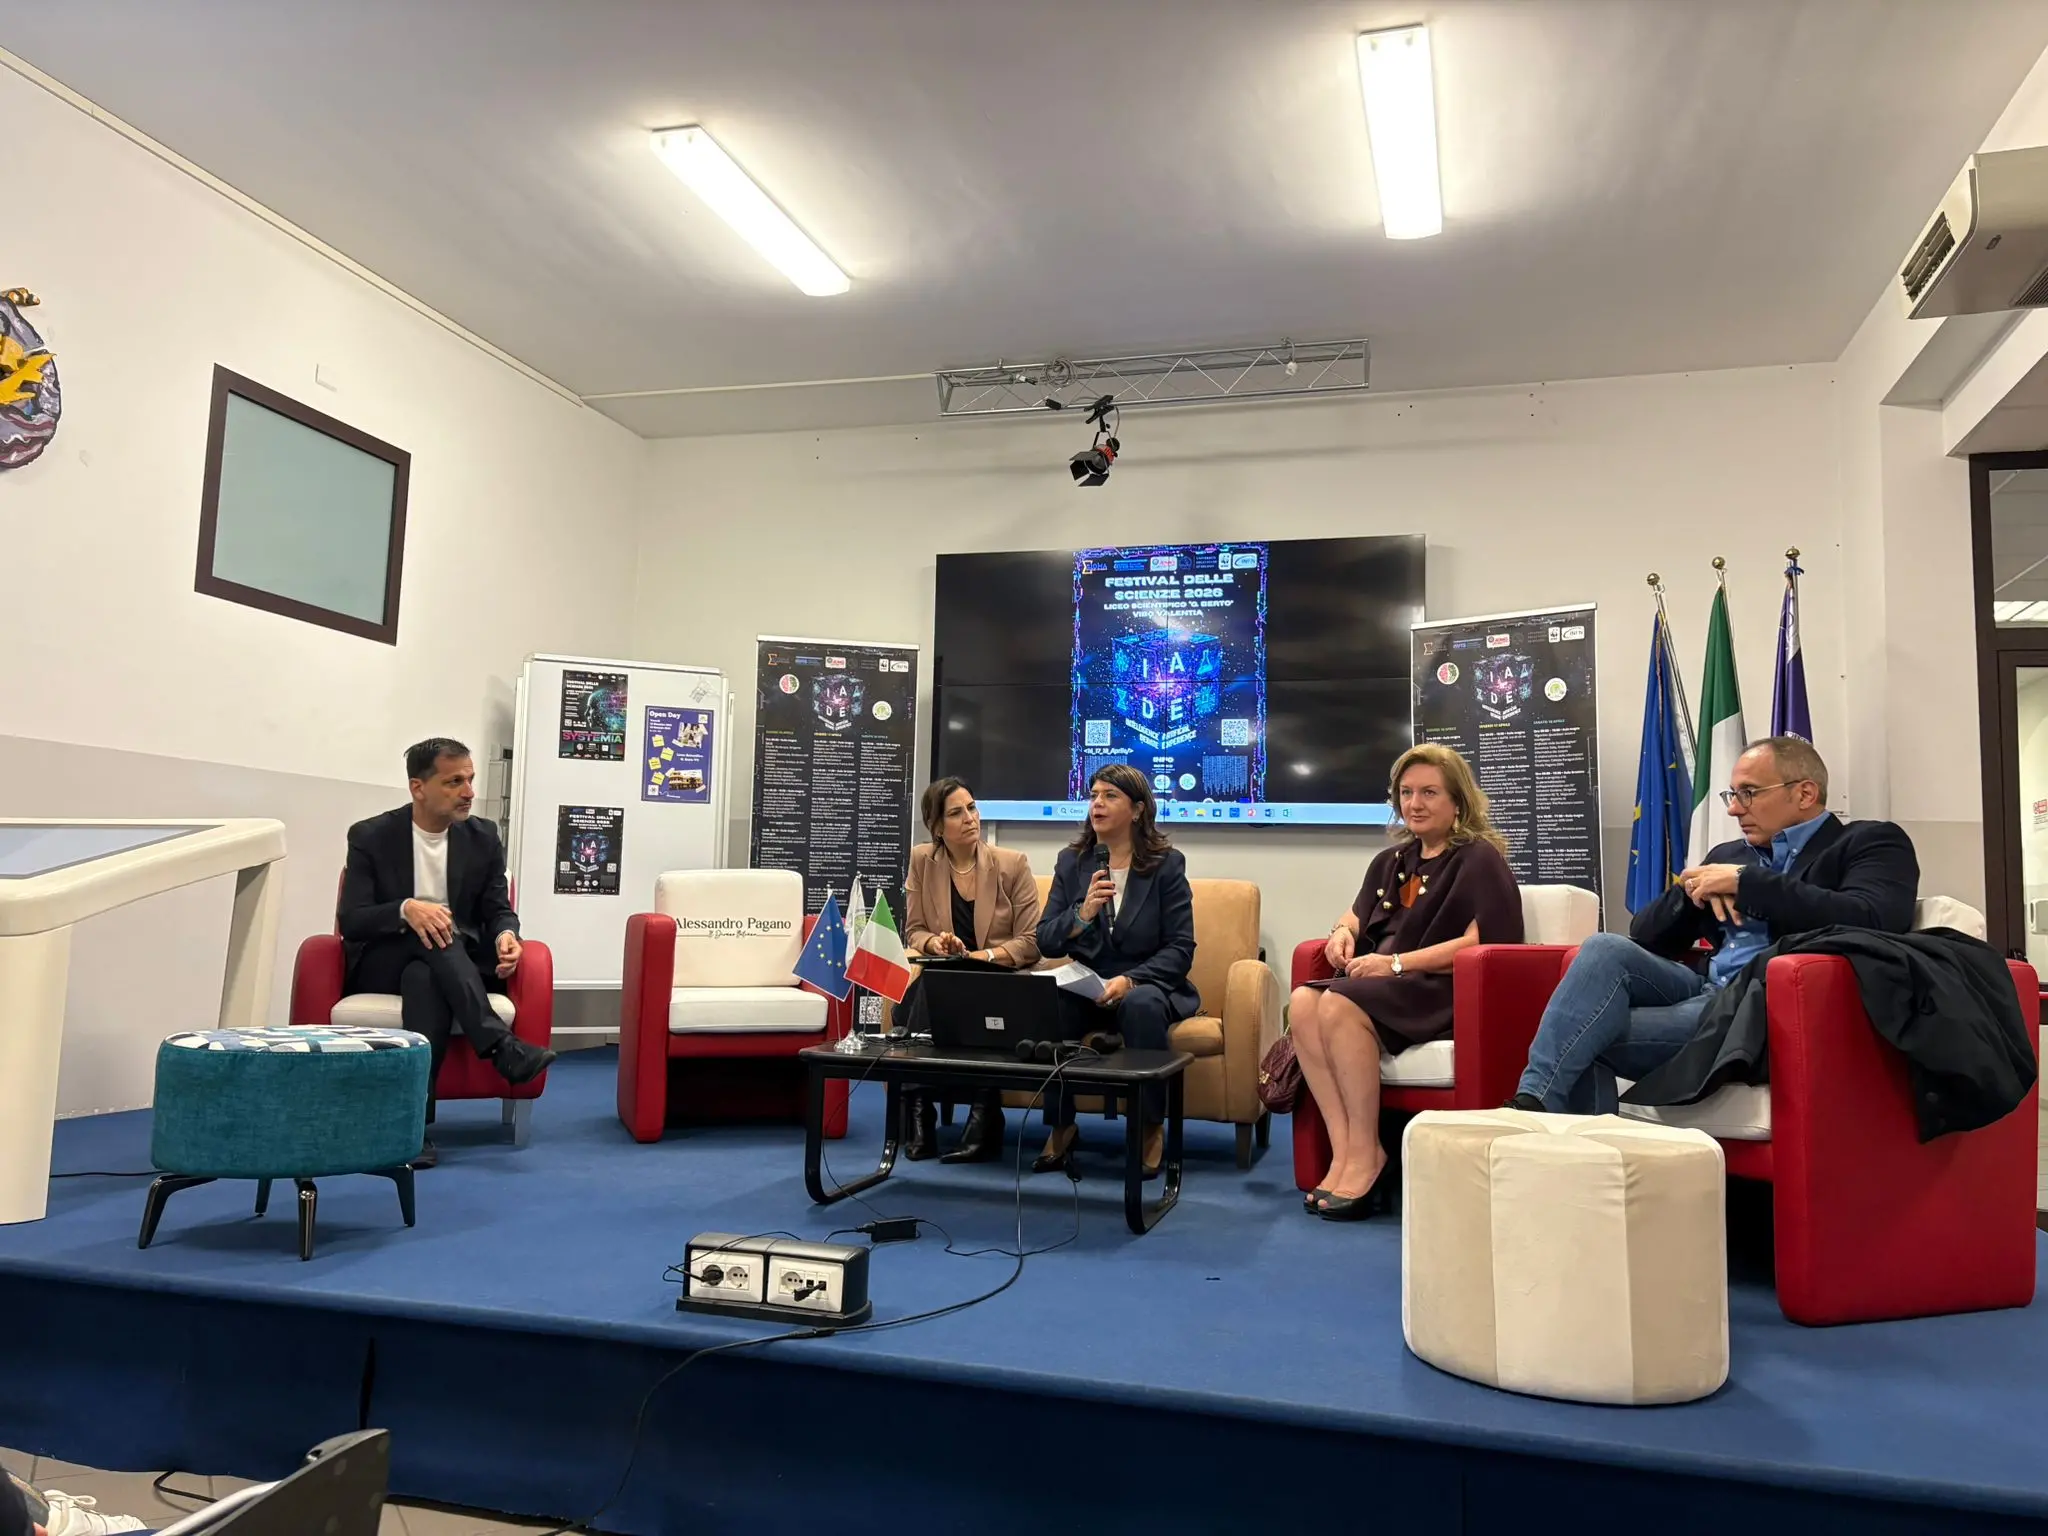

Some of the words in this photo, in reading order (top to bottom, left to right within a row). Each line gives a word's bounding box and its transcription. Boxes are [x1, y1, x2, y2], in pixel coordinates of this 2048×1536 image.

[1105, 575, 1180, 587] FESTIVAL
[1183, 573, 1234, 585] DELLE
[1114, 588, 1180, 600] SCIENZE
[1184, 587, 1223, 598] 2026
[1131, 601, 1187, 609] SCIENTIFICO
[1157, 609, 1204, 618] VALENTIA
[1169, 652, 1185, 673] A
[1504, 666, 1513, 679] A
[839, 685, 847, 696] A
[1491, 691, 1498, 704] D
[1506, 691, 1513, 704] E
[649, 710, 667, 718] Open
[667, 711, 681, 720] Day
[839, 706, 846, 718] E
[1142, 697, 1154, 719] D
[1170, 698, 1183, 721] E
[562, 732, 623, 743] SYSTEMIA
[676, 917, 743, 929] Alessandro
[747, 917, 792, 932] Pagano
